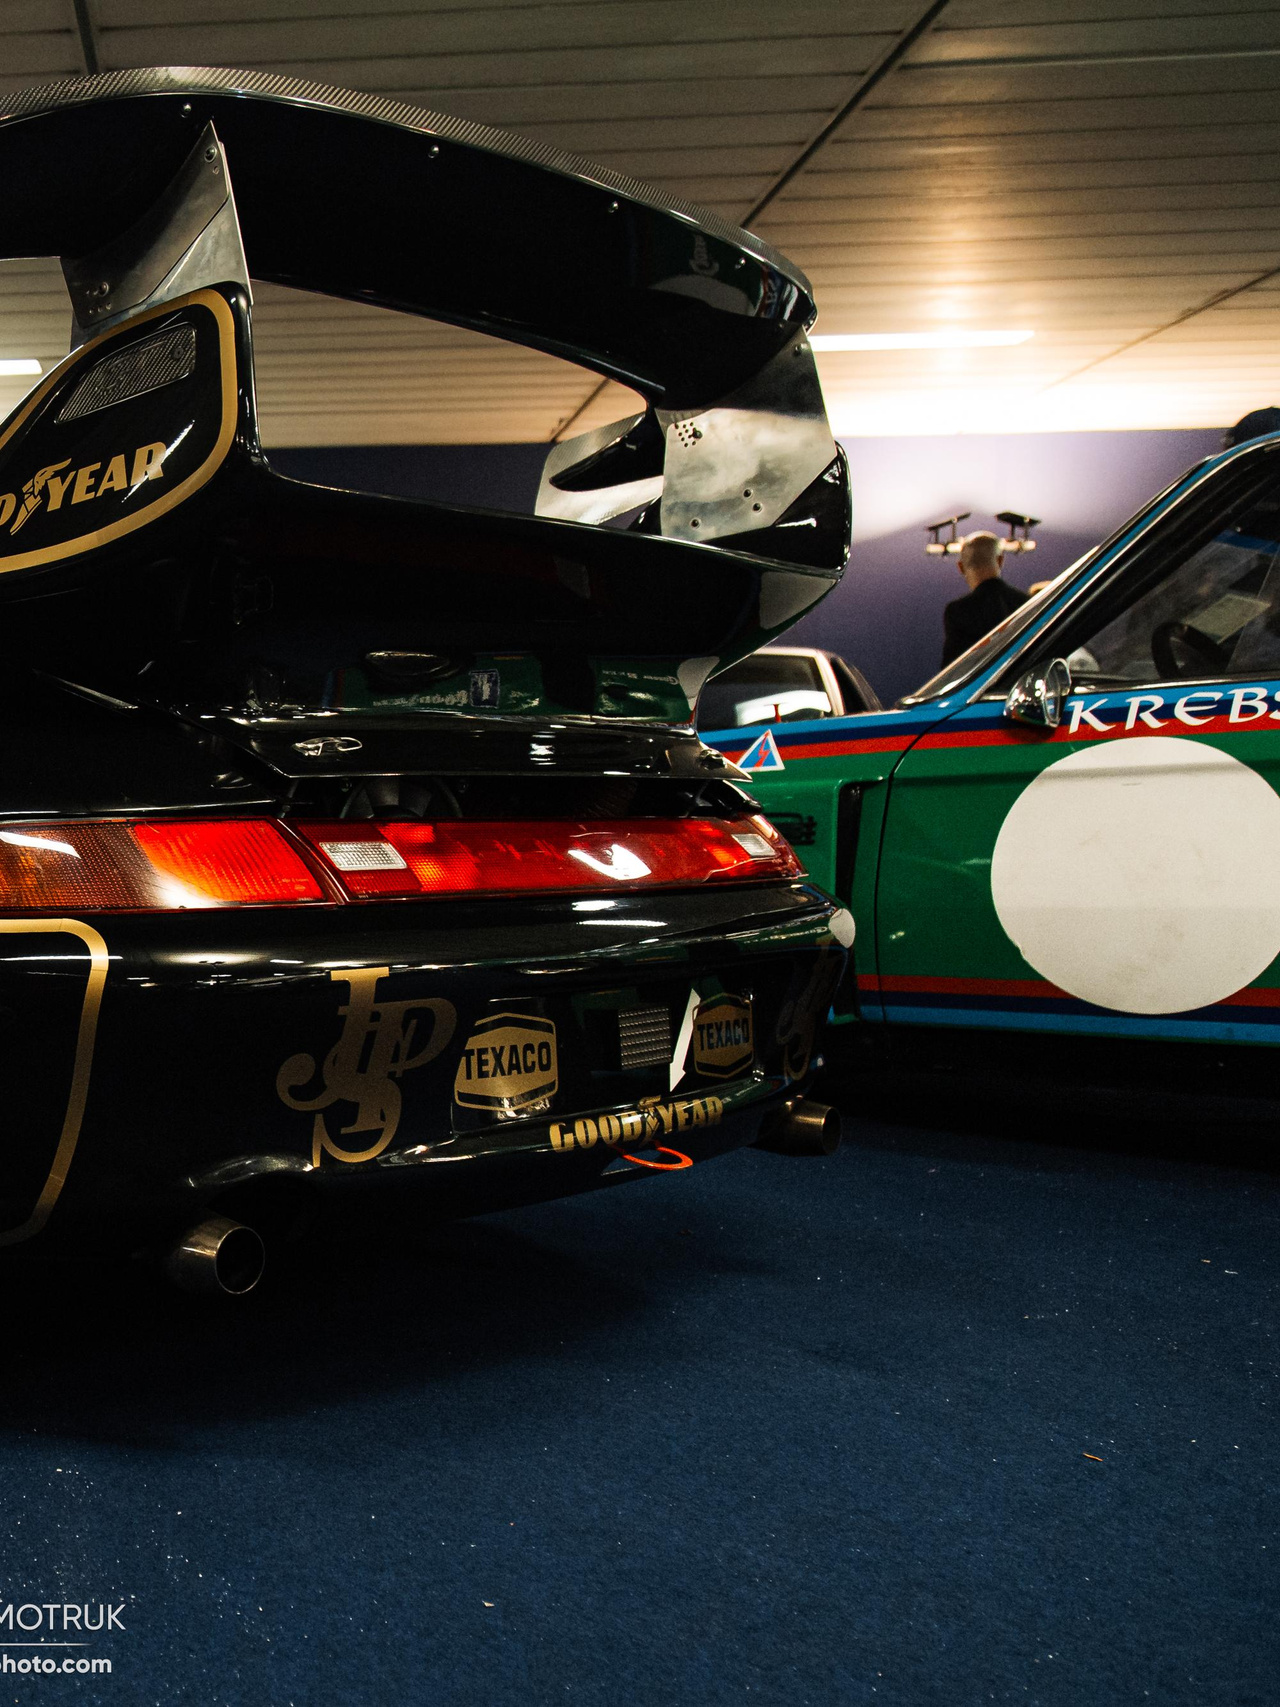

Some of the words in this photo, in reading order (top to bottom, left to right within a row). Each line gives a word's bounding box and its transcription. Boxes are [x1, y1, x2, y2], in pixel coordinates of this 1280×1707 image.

[1068, 686, 1280, 734] KREB
[696, 1018, 750, 1051] TEXACO
[462, 1041, 552, 1080] TEXACO
